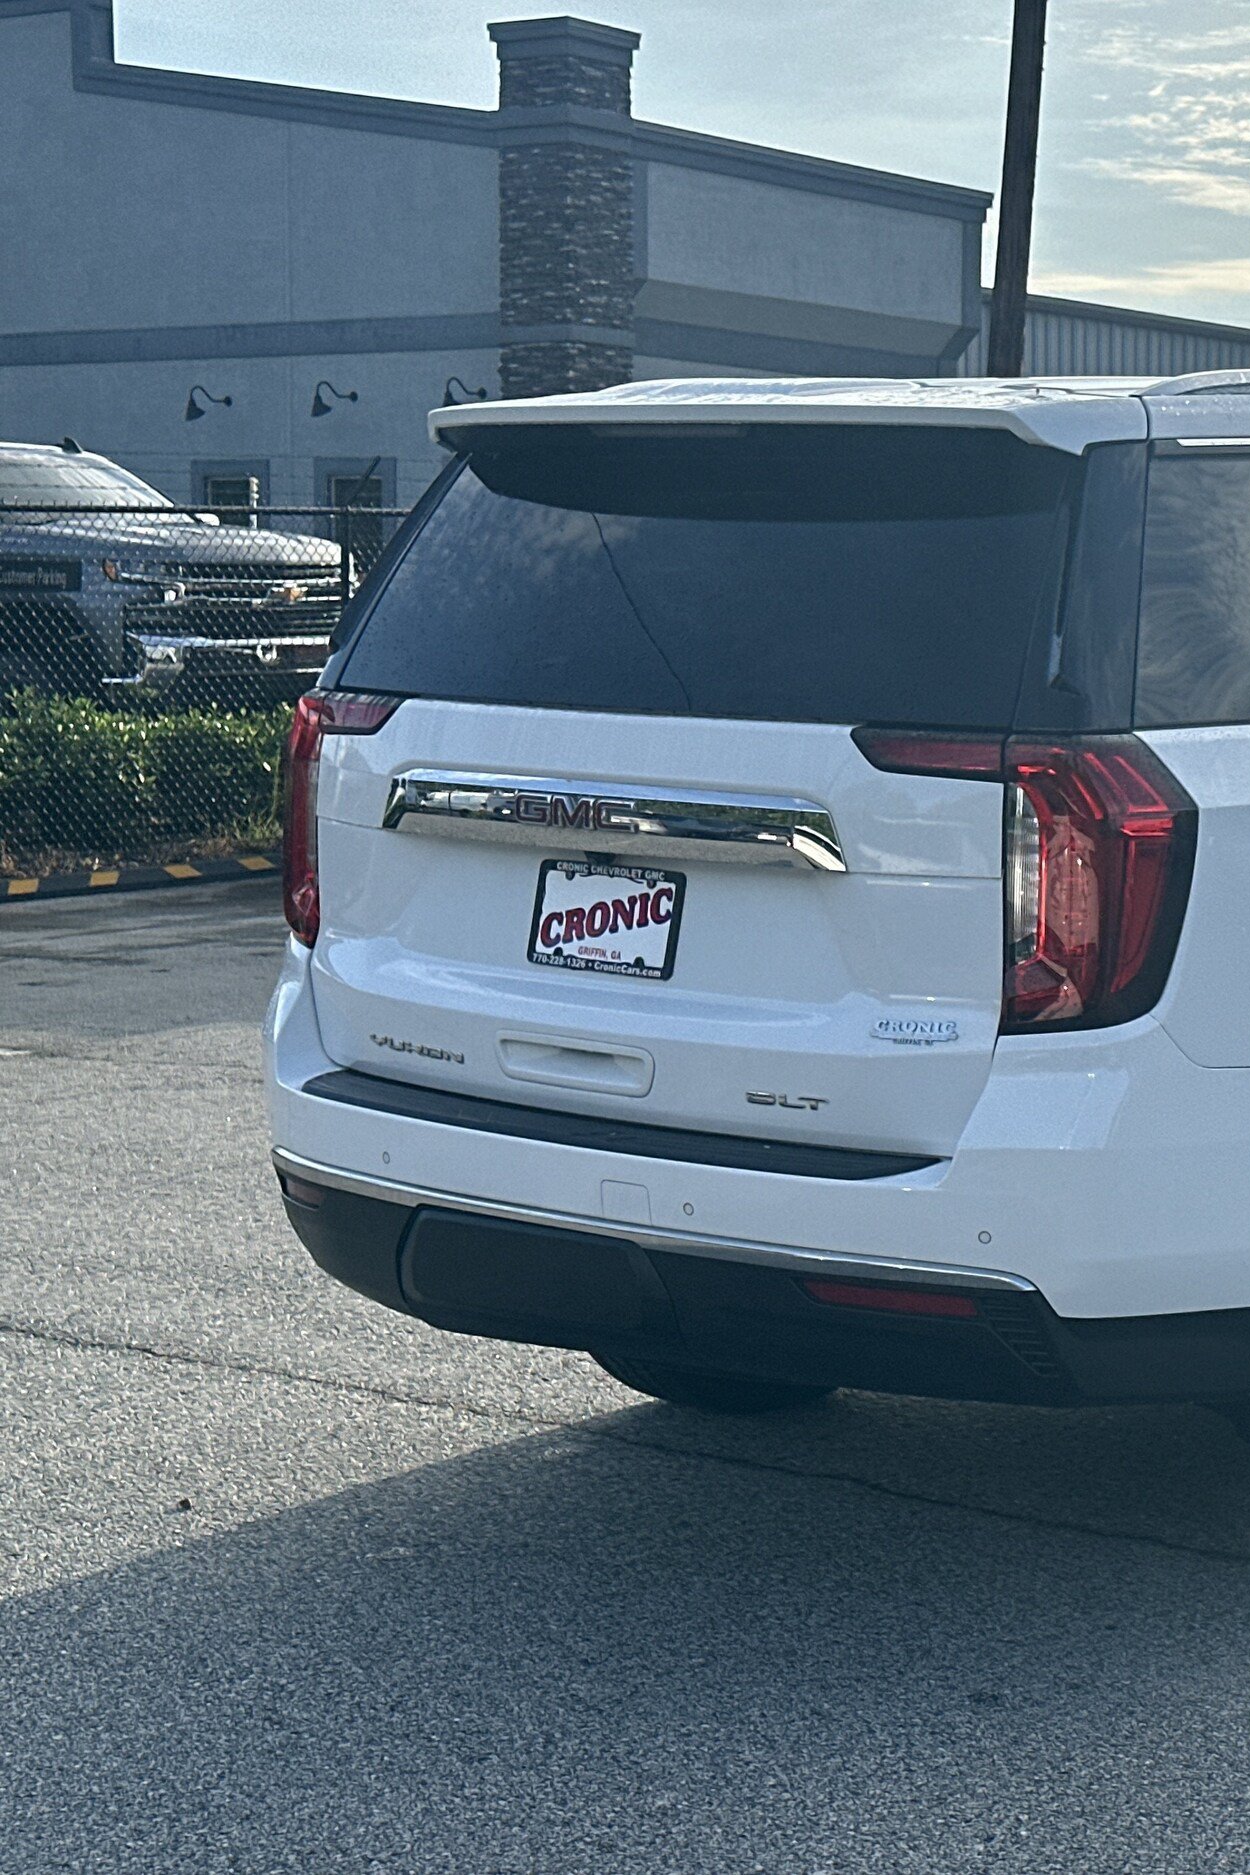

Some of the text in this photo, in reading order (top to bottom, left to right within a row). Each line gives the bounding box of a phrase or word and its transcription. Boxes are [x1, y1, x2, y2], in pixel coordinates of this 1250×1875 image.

[515, 791, 638, 833] GMC
[556, 861, 666, 881] CRONIC CHEVROLET GMC
[540, 887, 674, 948] CRONIC
[577, 946, 622, 961] GRIFFIN, GA
[593, 961, 661, 977] CronicCars.com
[874, 1019, 957, 1034] CRONIC
[368, 1032, 465, 1065] YUKON
[745, 1090, 830, 1112] SLT
